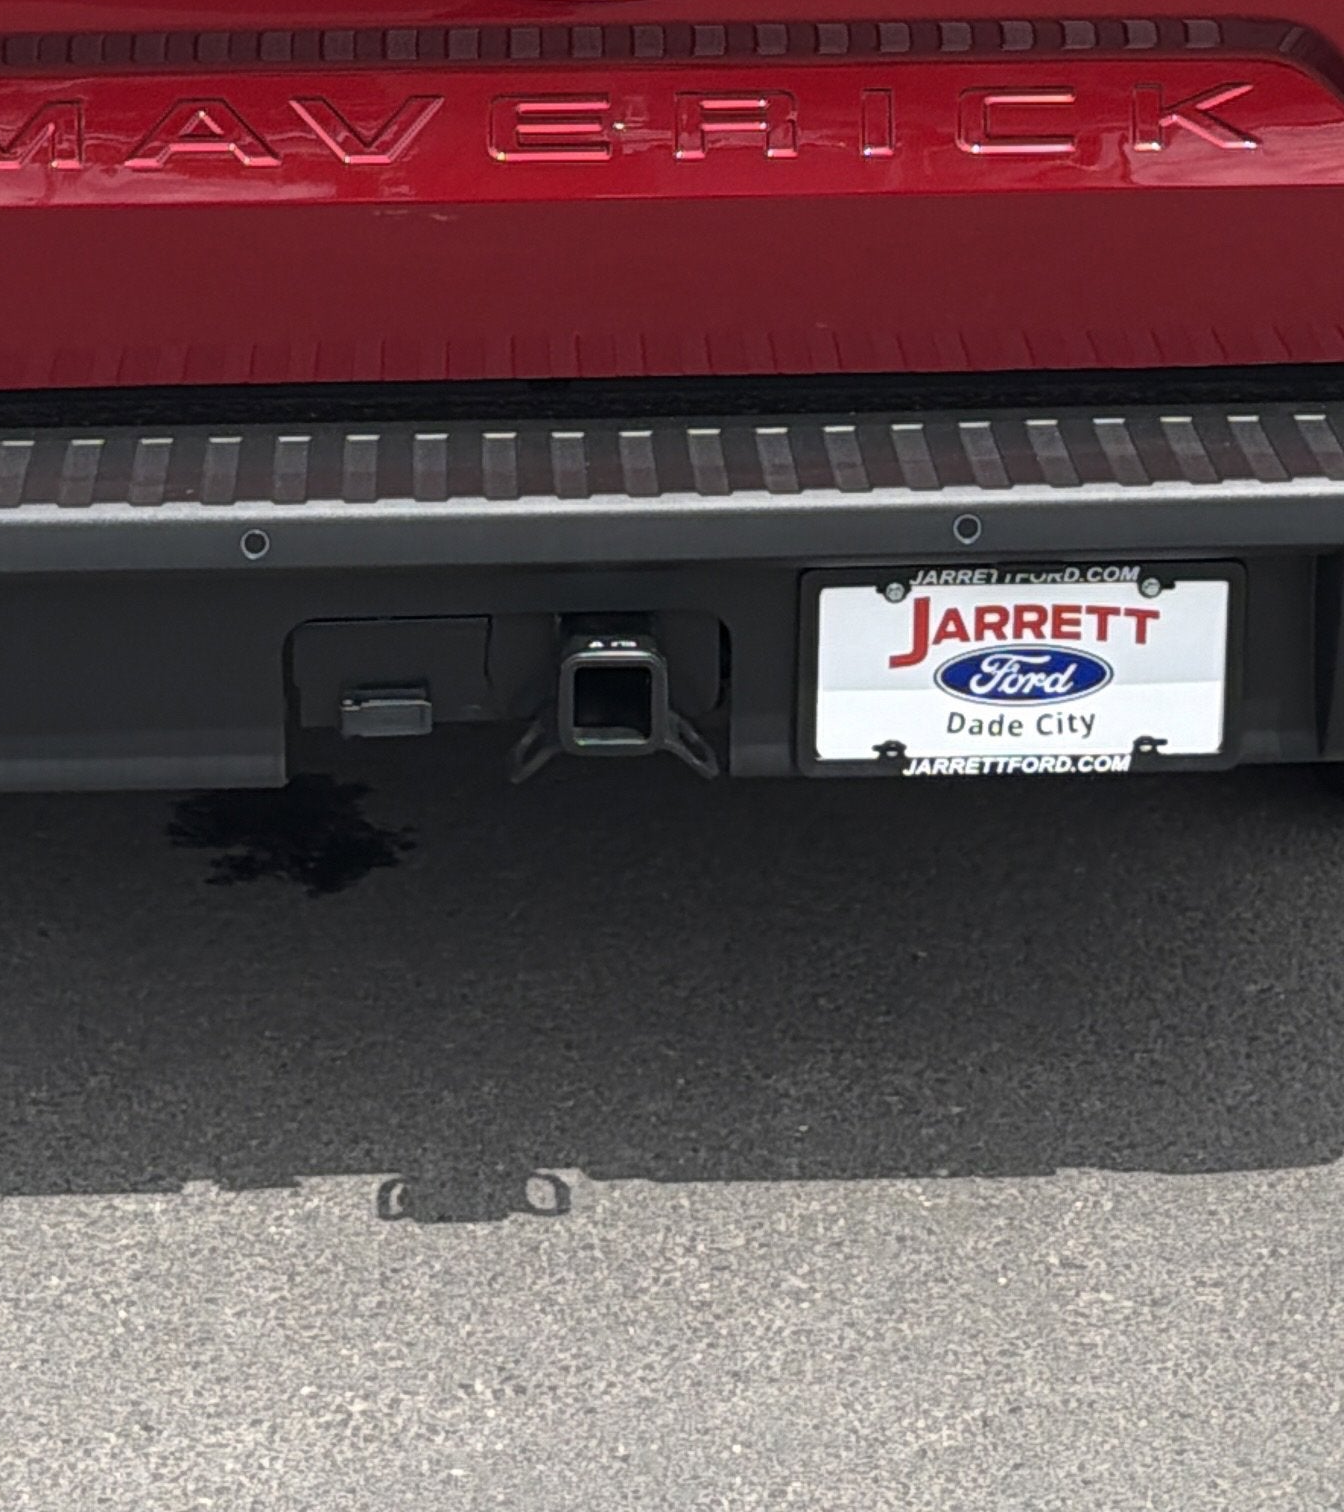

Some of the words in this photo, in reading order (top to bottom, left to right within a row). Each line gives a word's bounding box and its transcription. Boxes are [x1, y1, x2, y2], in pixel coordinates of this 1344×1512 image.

[889, 596, 1160, 669] JARRETT
[969, 653, 1077, 695] Ford
[946, 711, 1024, 737] Dade
[1035, 712, 1096, 737] City
[902, 754, 1133, 777] JARRETTFORD.COM
